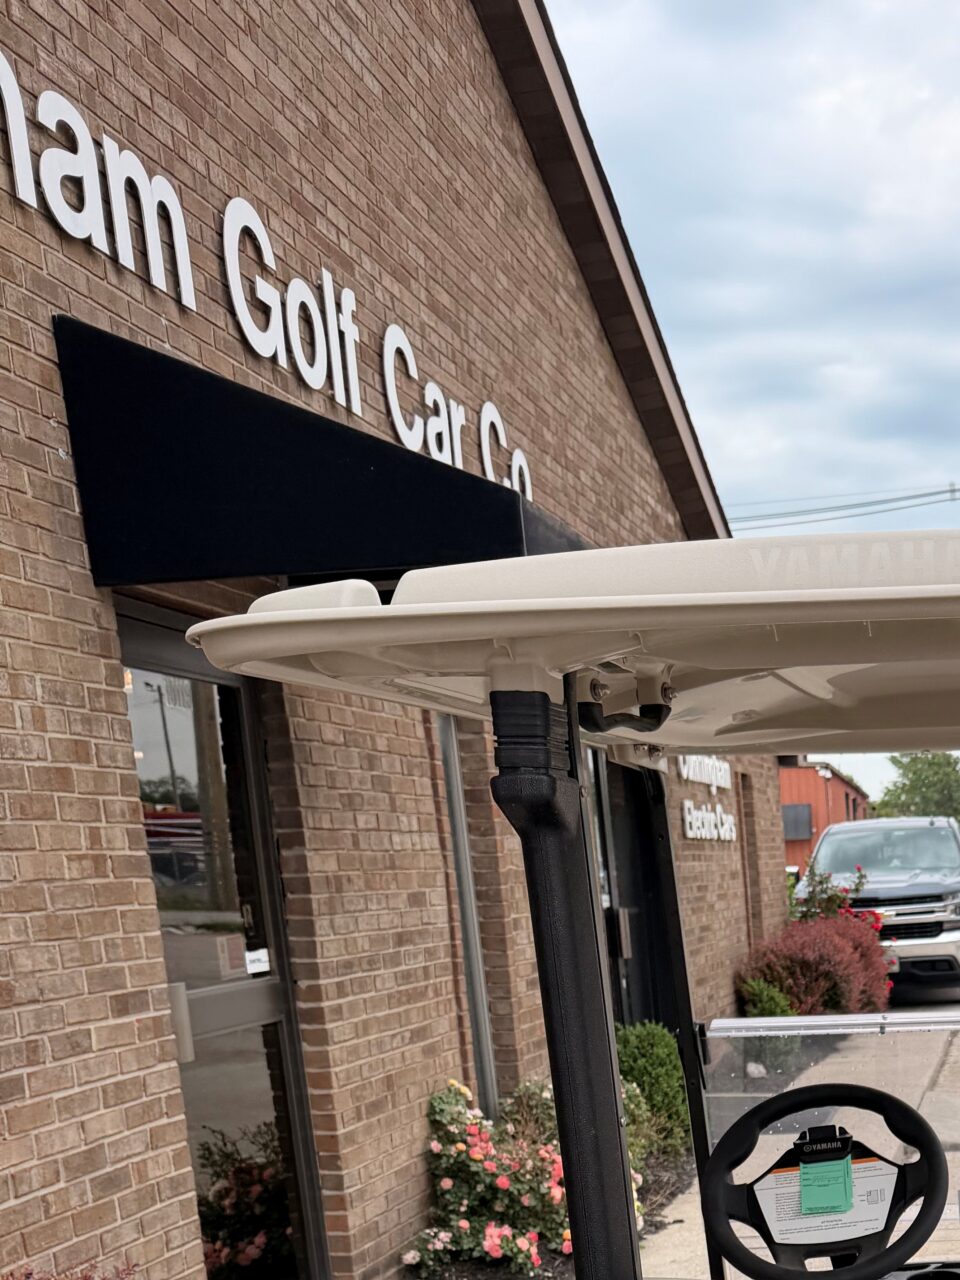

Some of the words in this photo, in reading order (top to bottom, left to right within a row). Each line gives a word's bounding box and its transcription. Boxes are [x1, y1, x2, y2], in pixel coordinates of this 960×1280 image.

[223, 197, 362, 418] Golf
[384, 323, 466, 470] Car
[812, 1141, 842, 1151] YAMAHA
